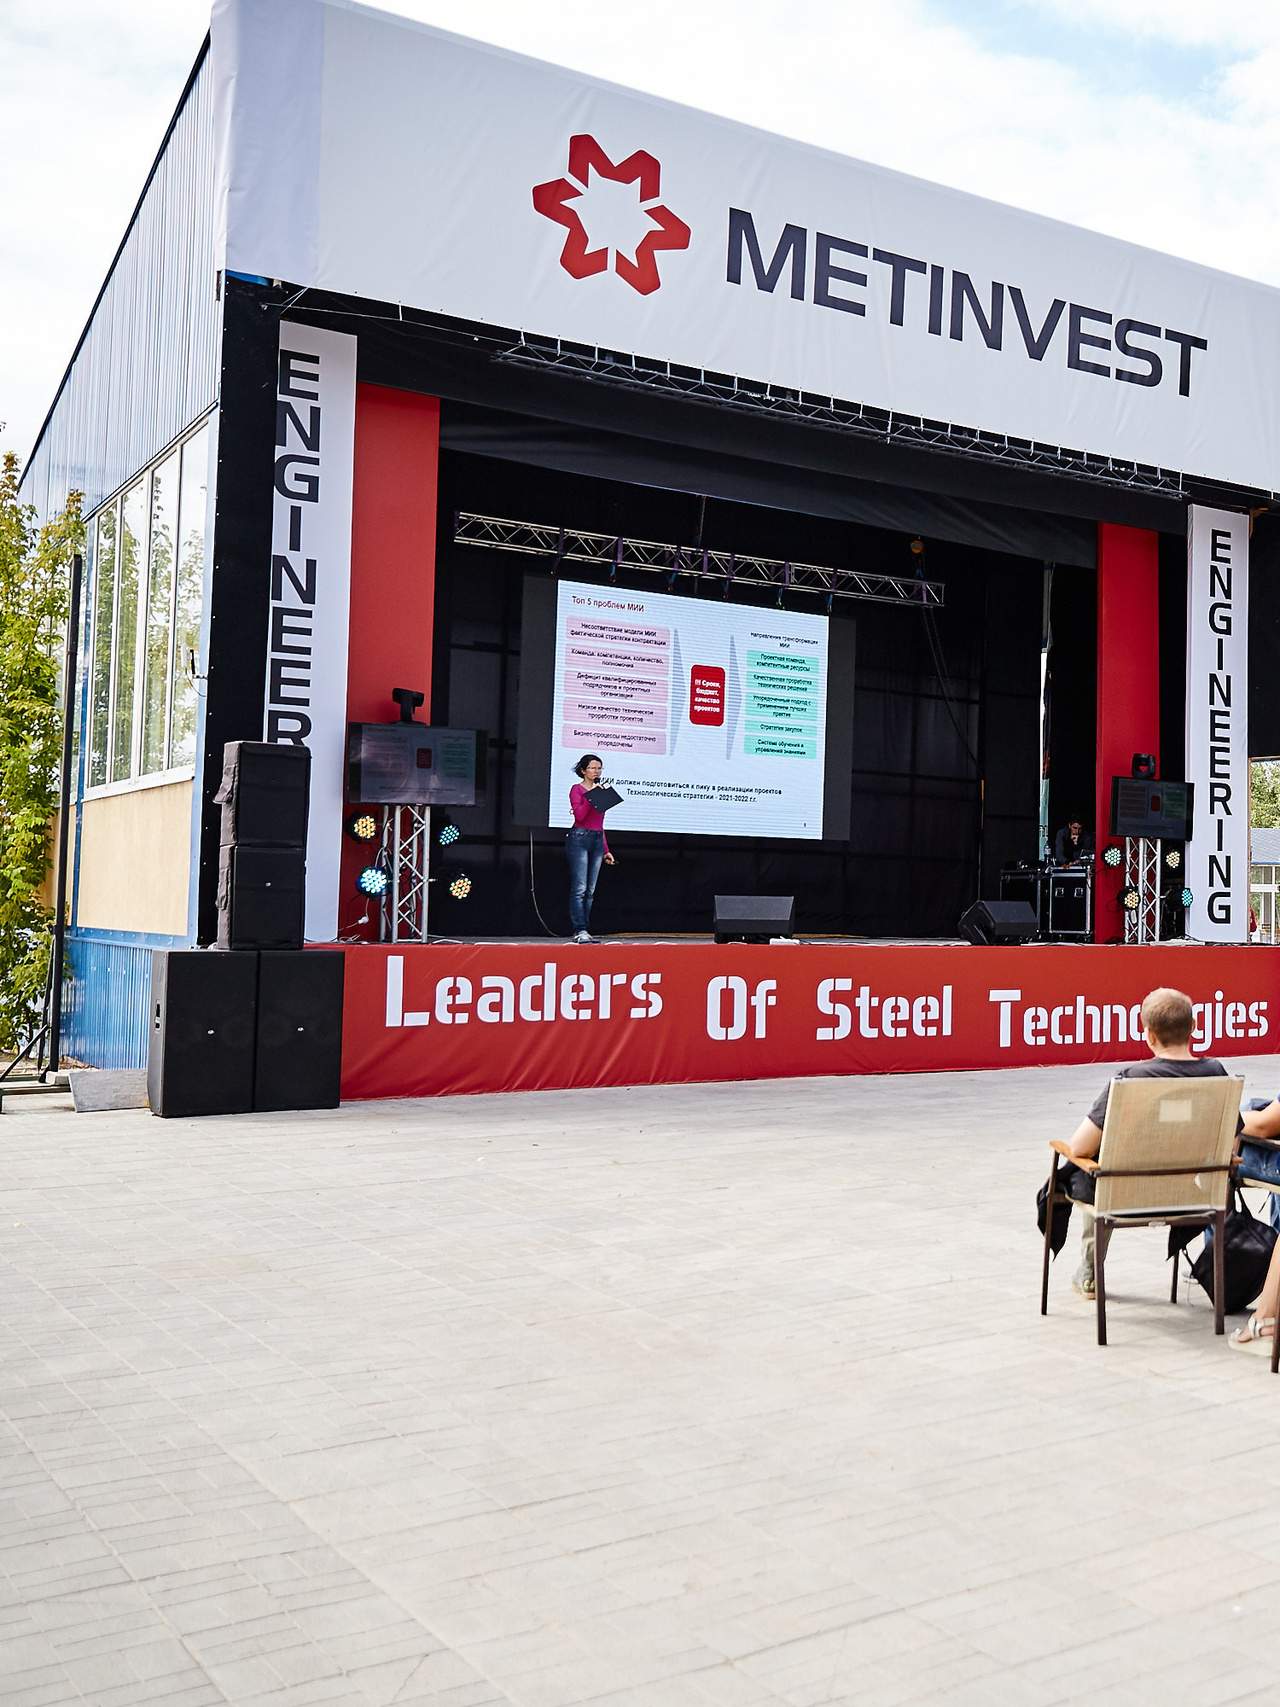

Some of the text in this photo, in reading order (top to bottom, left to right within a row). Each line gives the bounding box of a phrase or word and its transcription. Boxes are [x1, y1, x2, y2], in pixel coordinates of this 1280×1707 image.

[726, 207, 1208, 398] METINVEST
[572, 596, 585, 604] Топ
[594, 599, 625, 611] проблем
[628, 603, 644, 612] МИИ
[1207, 529, 1232, 925] ENGINEERING
[627, 788, 681, 798] Технологической
[683, 793, 714, 801] стратегии
[719, 794, 749, 802] 2021-2022
[642, 781, 690, 789] подготовиться
[717, 786, 753, 794] реализации
[754, 788, 782, 796] проектов
[386, 955, 1269, 1052] Leaders Of Steel Technogies
